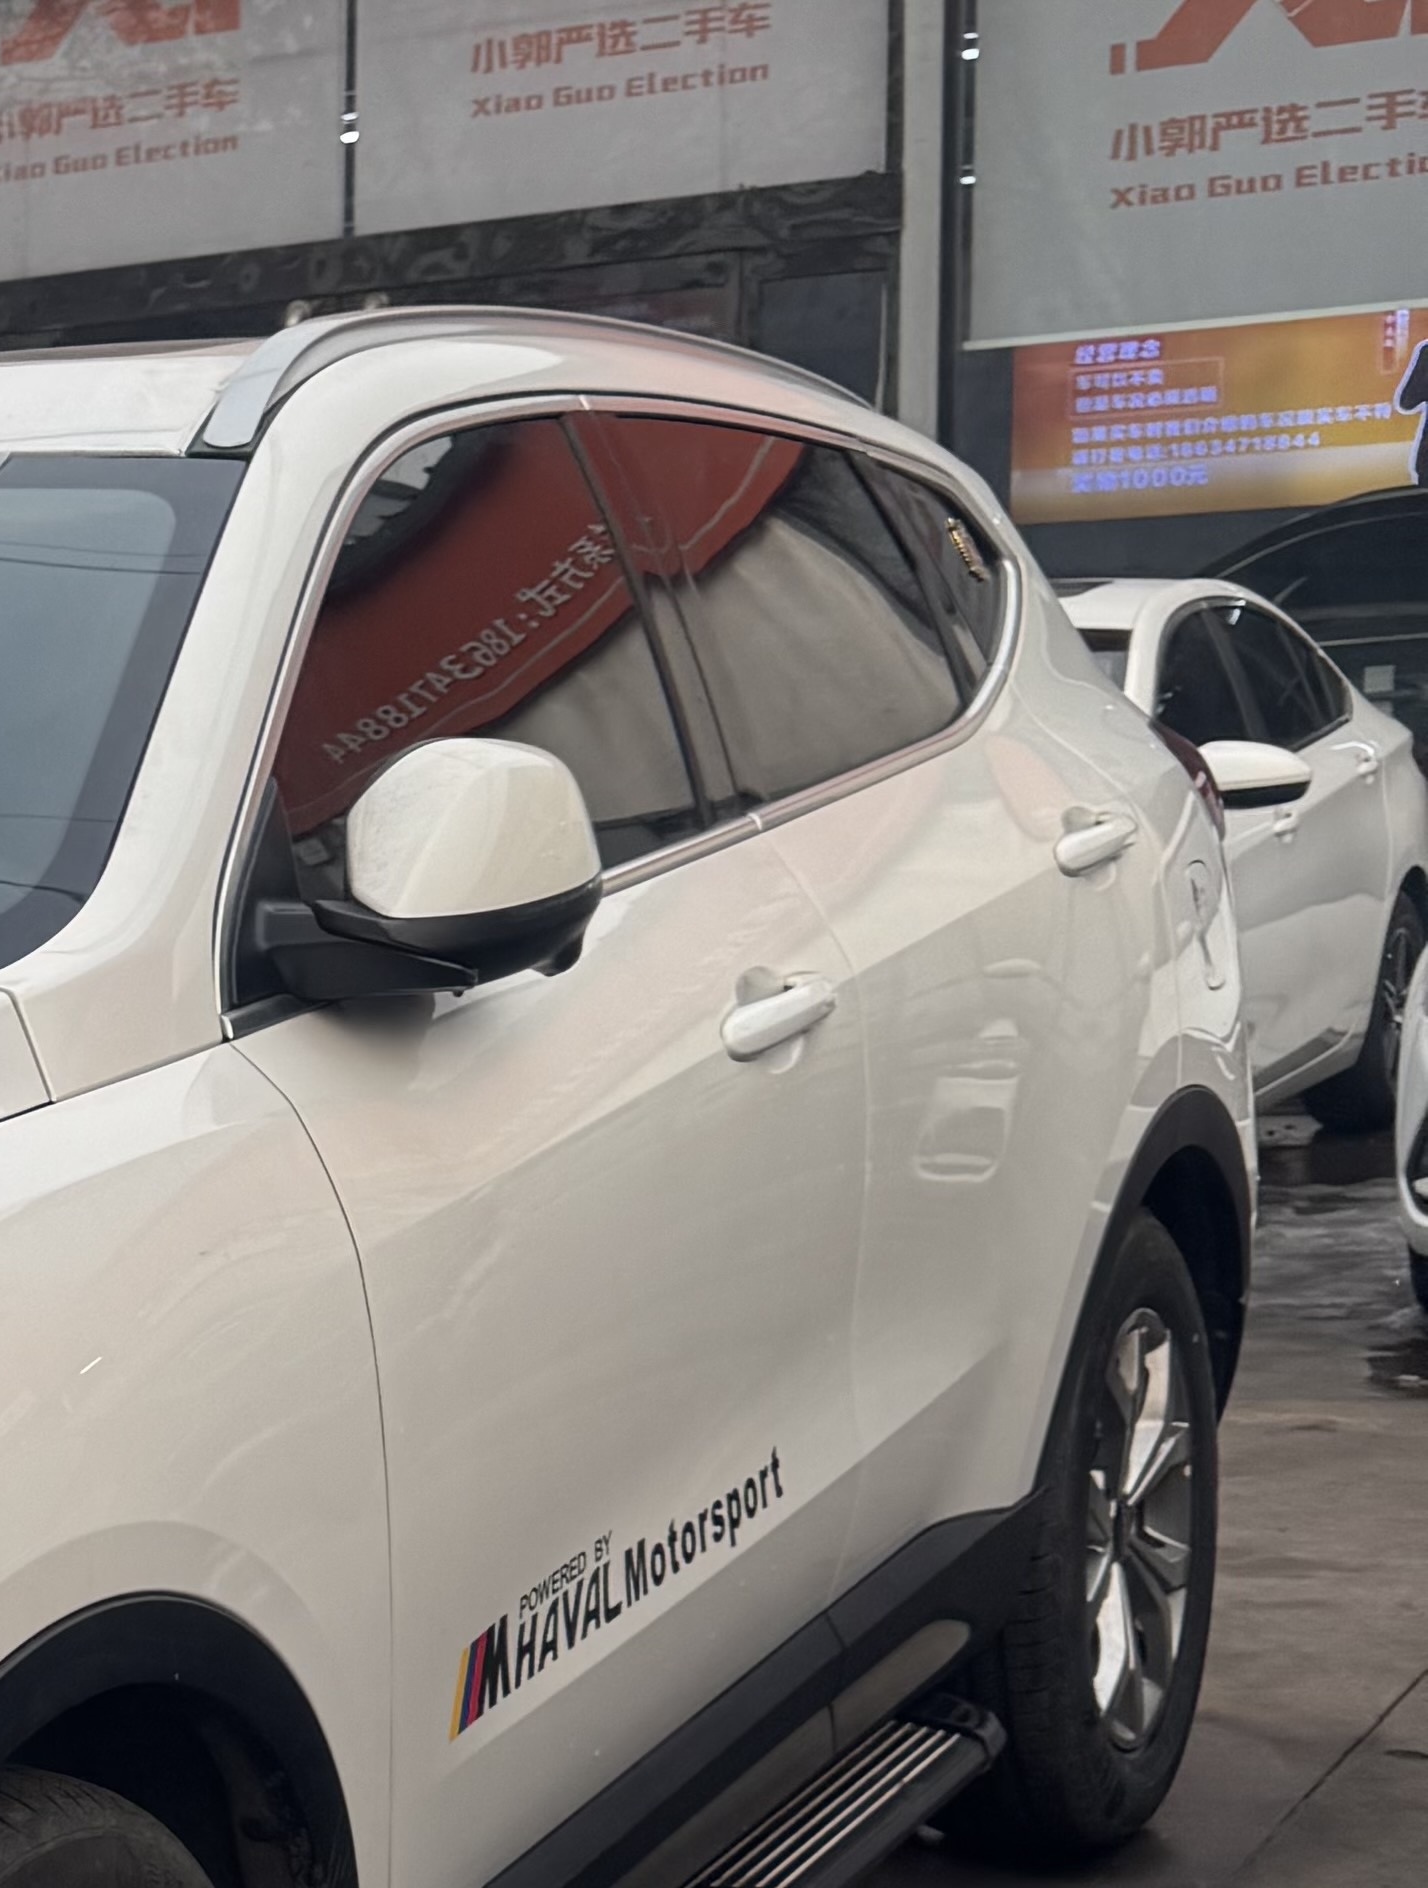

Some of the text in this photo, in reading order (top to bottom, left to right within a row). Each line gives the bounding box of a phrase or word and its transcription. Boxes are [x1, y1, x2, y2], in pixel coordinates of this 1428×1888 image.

[471, 2, 771, 74] 小郭严选二手车
[471, 63, 769, 119] Xiao Guo Election
[1110, 88, 1428, 161] 小郭严选二手
[53, 152, 107, 175] Guo
[115, 134, 238, 167] Election
[1110, 183, 1196, 209] Xiao
[1207, 174, 1282, 198] Guo
[514, 1560, 623, 1690] HAVAL
[624, 1446, 783, 1608] Motorsport
[519, 1530, 612, 1619] POWERED BY
